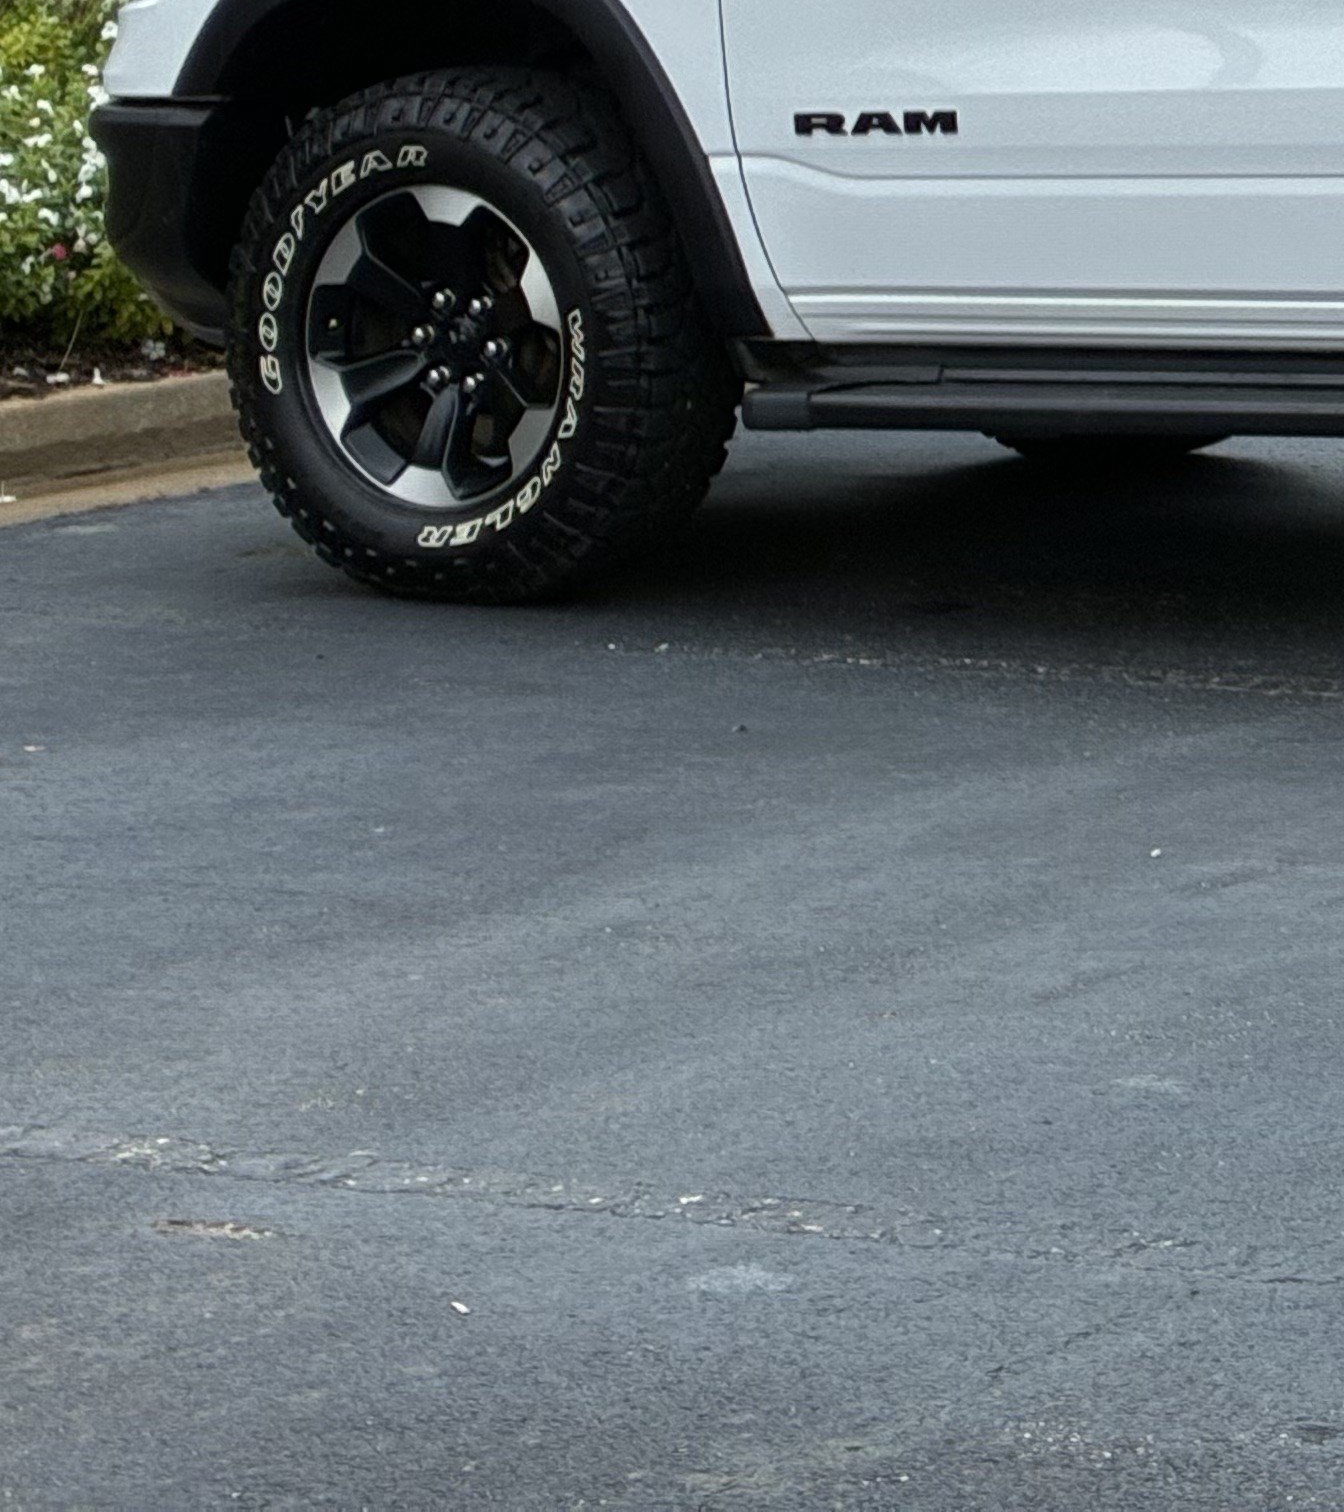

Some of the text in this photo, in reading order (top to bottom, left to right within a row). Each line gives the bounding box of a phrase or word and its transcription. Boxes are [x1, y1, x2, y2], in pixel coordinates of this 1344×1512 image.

[794, 111, 958, 134] RAM
[259, 144, 427, 393] GOODYEAR
[417, 310, 585, 547] WRANGLER
